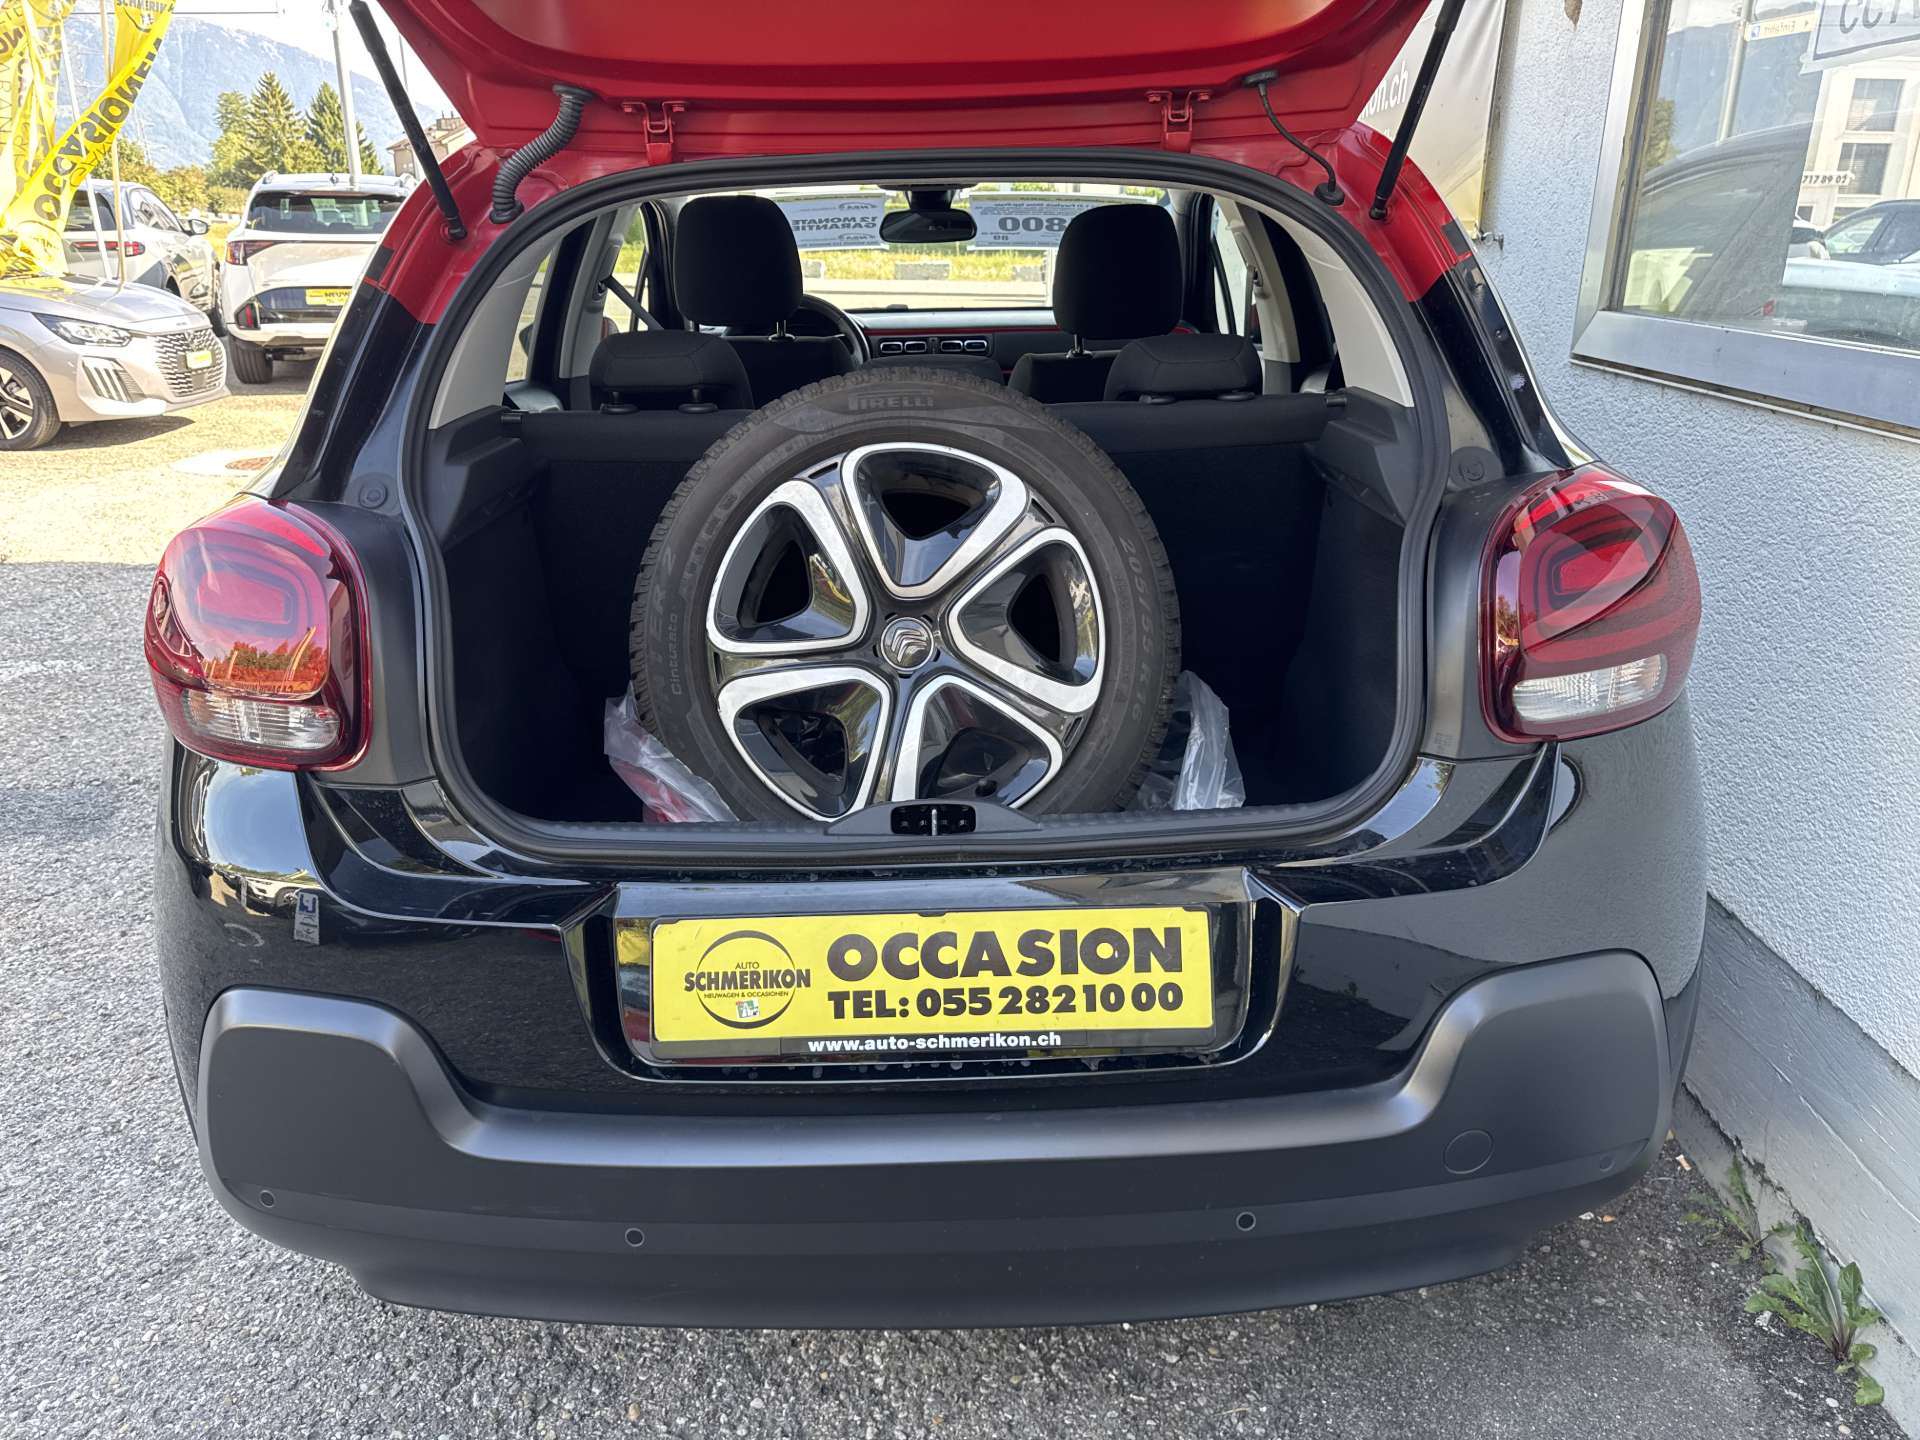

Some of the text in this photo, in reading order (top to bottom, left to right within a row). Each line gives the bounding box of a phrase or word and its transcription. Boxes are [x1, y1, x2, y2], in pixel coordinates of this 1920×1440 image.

[848, 390, 935, 411] PIRELLI
[827, 927, 1183, 982] OCCASION
[735, 962, 760, 970] AUTO
[684, 969, 811, 992] SCHMERIKON
[747, 990, 789, 998] OCCASIONEN
[828, 989, 909, 1019] TEL:
[916, 987, 993, 1017] 055
[1131, 982, 1183, 1012] 00
[808, 1031, 1062, 1051] www.auto-schmerikon.ch
